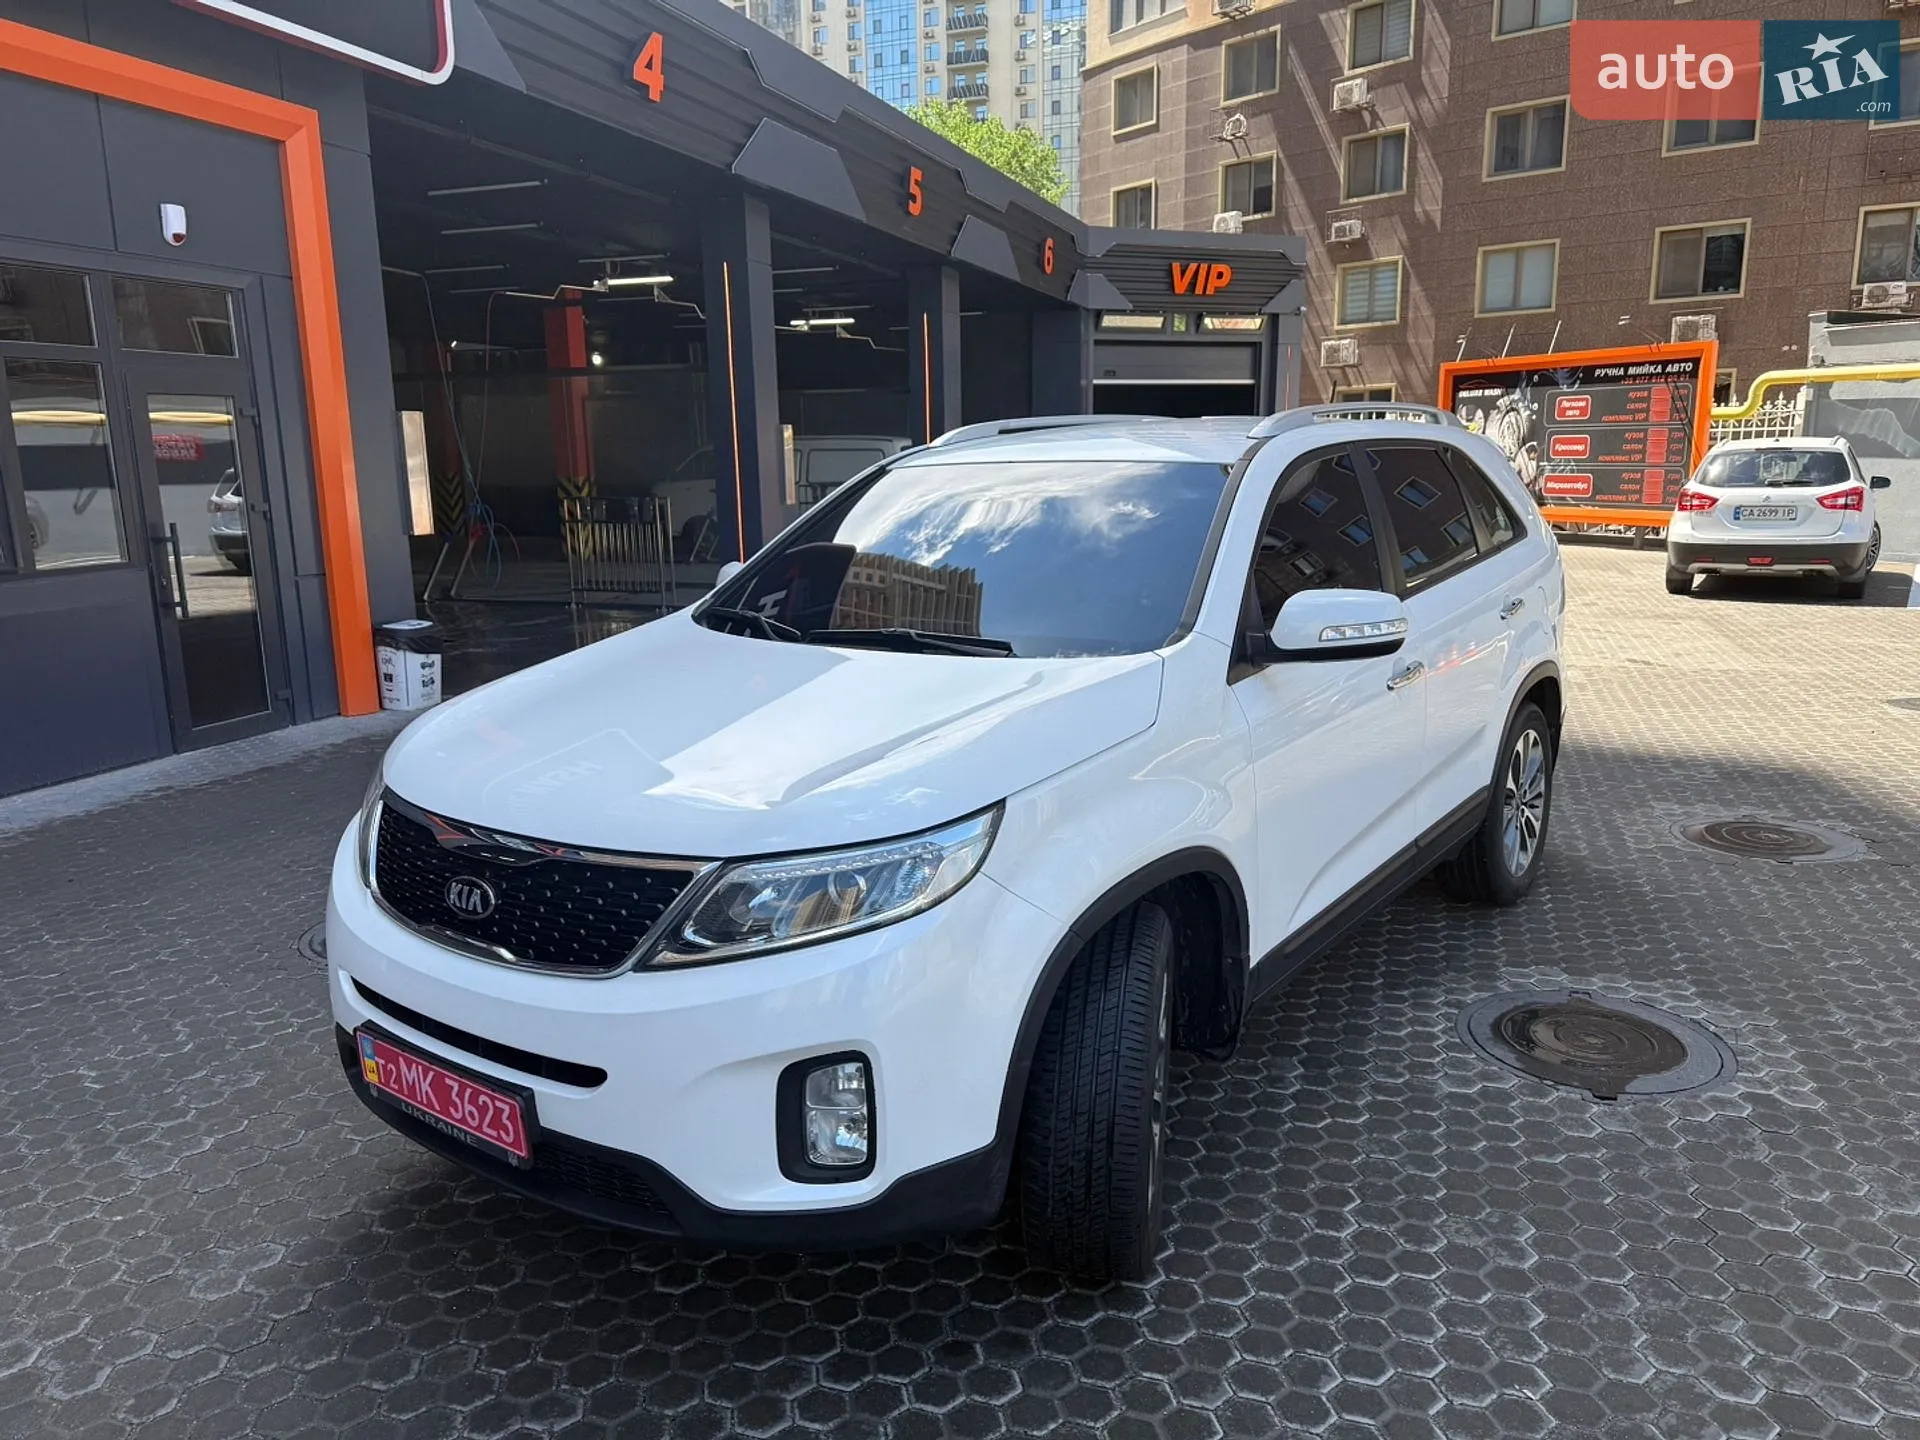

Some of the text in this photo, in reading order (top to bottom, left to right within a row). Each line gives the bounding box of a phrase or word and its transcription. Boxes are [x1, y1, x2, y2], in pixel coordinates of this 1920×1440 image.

[633, 32, 664, 102] 4
[908, 166, 924, 216] 5
[1043, 237, 1055, 275] 6
[1171, 262, 1232, 296] VIP
[1595, 362, 1693, 377] РУЧНА МИЙКА АВТО
[1741, 509, 1795, 517] CA 2699 IP
[450, 882, 483, 913] KIA
[401, 1102, 480, 1148] UKRAINE
[445, 1078, 514, 1144] 3623
